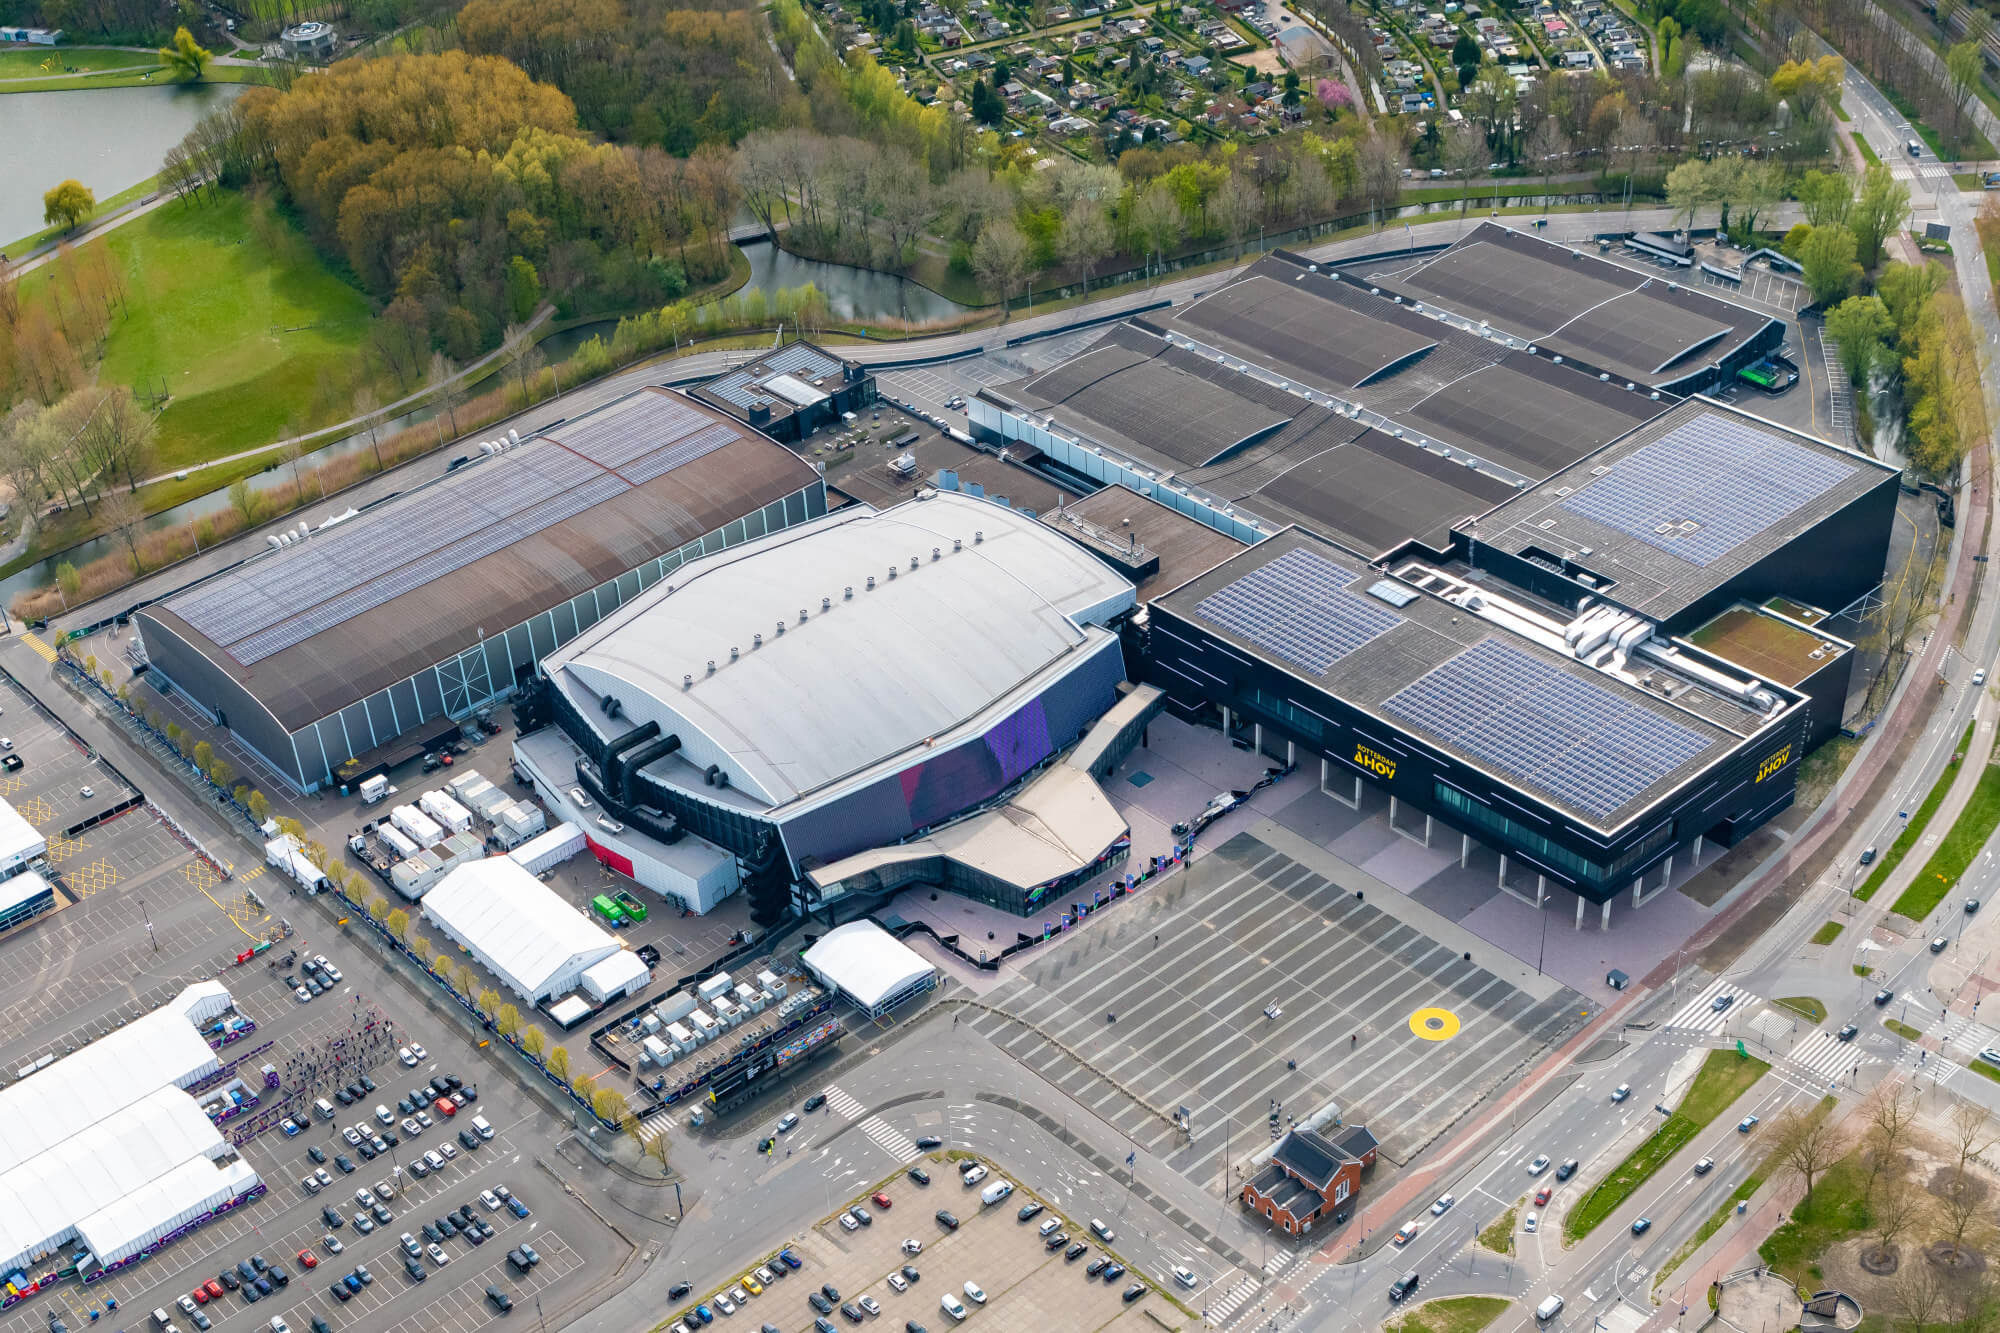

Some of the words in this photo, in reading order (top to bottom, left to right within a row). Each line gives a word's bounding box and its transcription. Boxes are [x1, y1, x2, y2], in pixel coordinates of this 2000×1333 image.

[1354, 751, 1396, 779] AHOY
[1357, 743, 1396, 768] ROTTERDAM
[1755, 751, 1790, 783] AHOY
